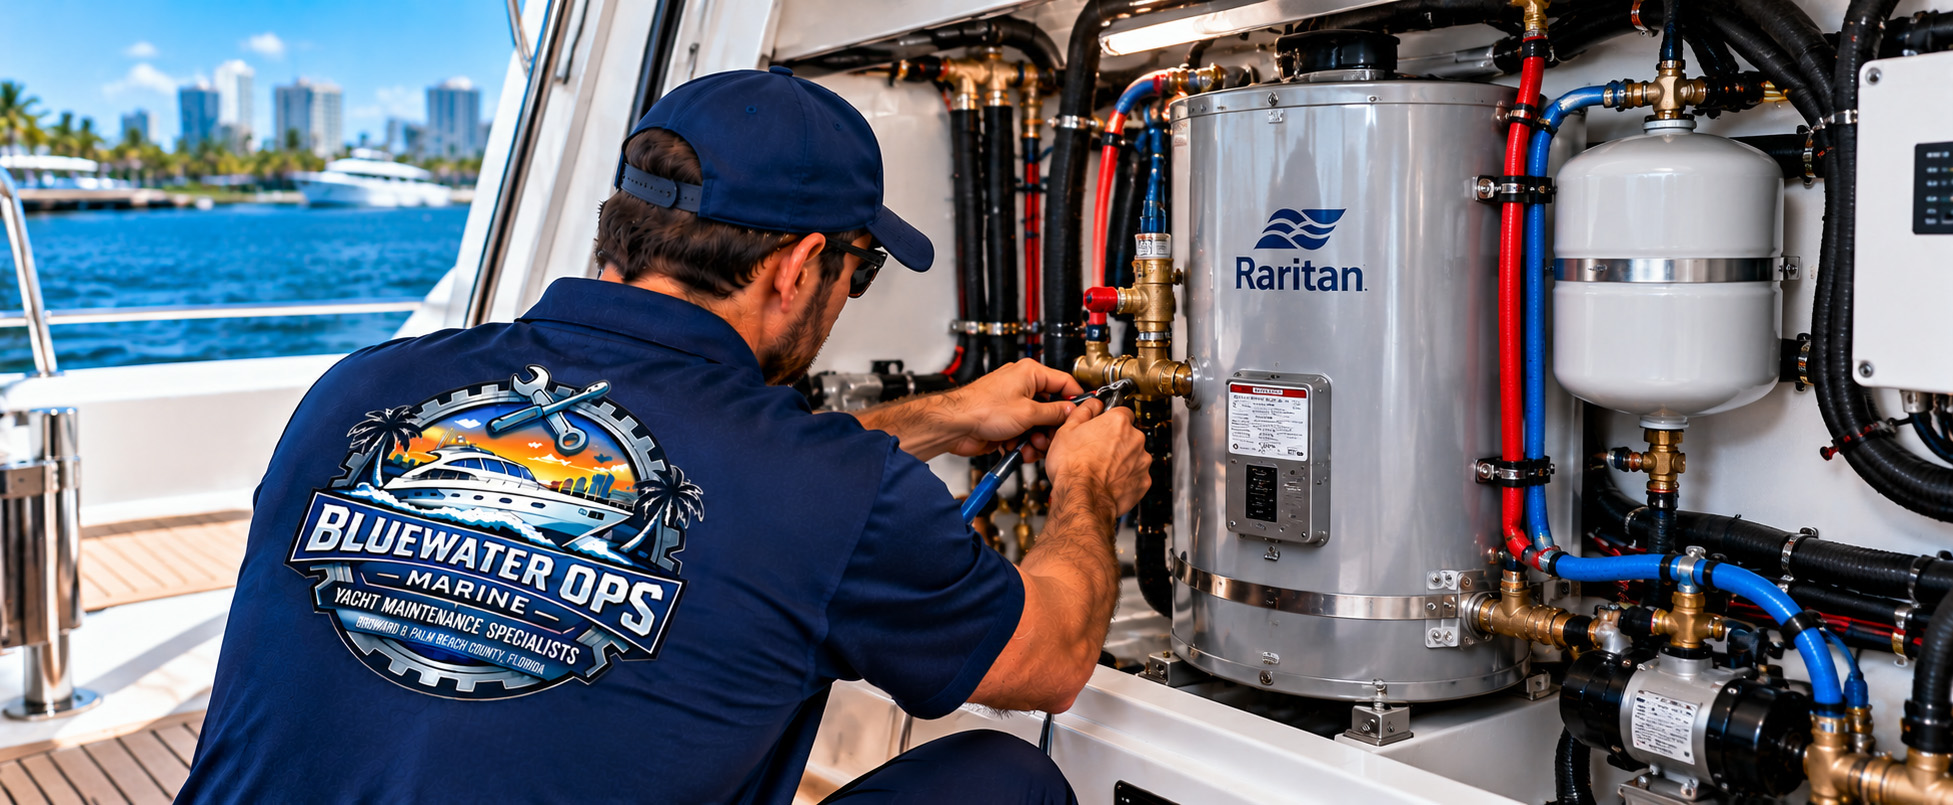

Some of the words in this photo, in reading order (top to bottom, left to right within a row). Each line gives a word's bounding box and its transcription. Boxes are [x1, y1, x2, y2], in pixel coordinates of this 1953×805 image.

[1235, 256, 1364, 291] Raritan
[305, 503, 555, 591] BLUEWATER
[559, 567, 664, 639] OPS
[405, 569, 531, 616] MARINE
[334, 586, 382, 611] YACHT
[380, 596, 484, 635] MAINTENANCE
[486, 623, 581, 666] SPECIALISTS
[408, 627, 435, 644] PALM
[435, 634, 467, 652] BEACH
